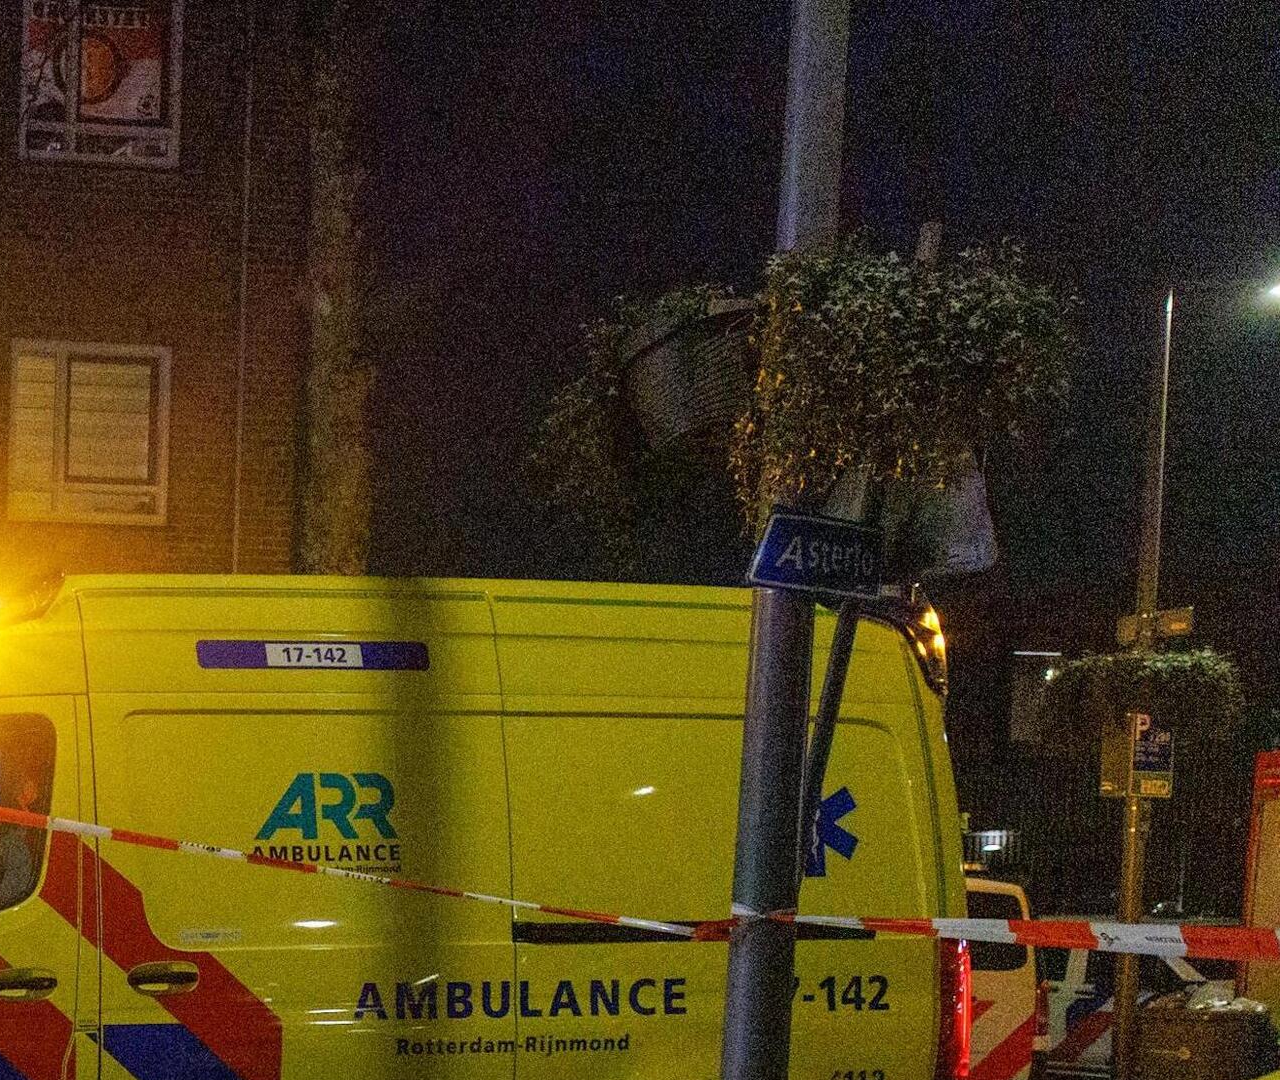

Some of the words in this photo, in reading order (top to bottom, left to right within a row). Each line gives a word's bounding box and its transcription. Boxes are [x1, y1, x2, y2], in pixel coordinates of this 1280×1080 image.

[774, 535, 875, 577] Asterlo
[282, 647, 348, 663] 17-142
[255, 772, 399, 840] ARR
[253, 844, 401, 862] AMBULANCE
[354, 978, 687, 1020] AMBULANCE
[396, 1033, 631, 1057] Rotterdam-Rijnmond
